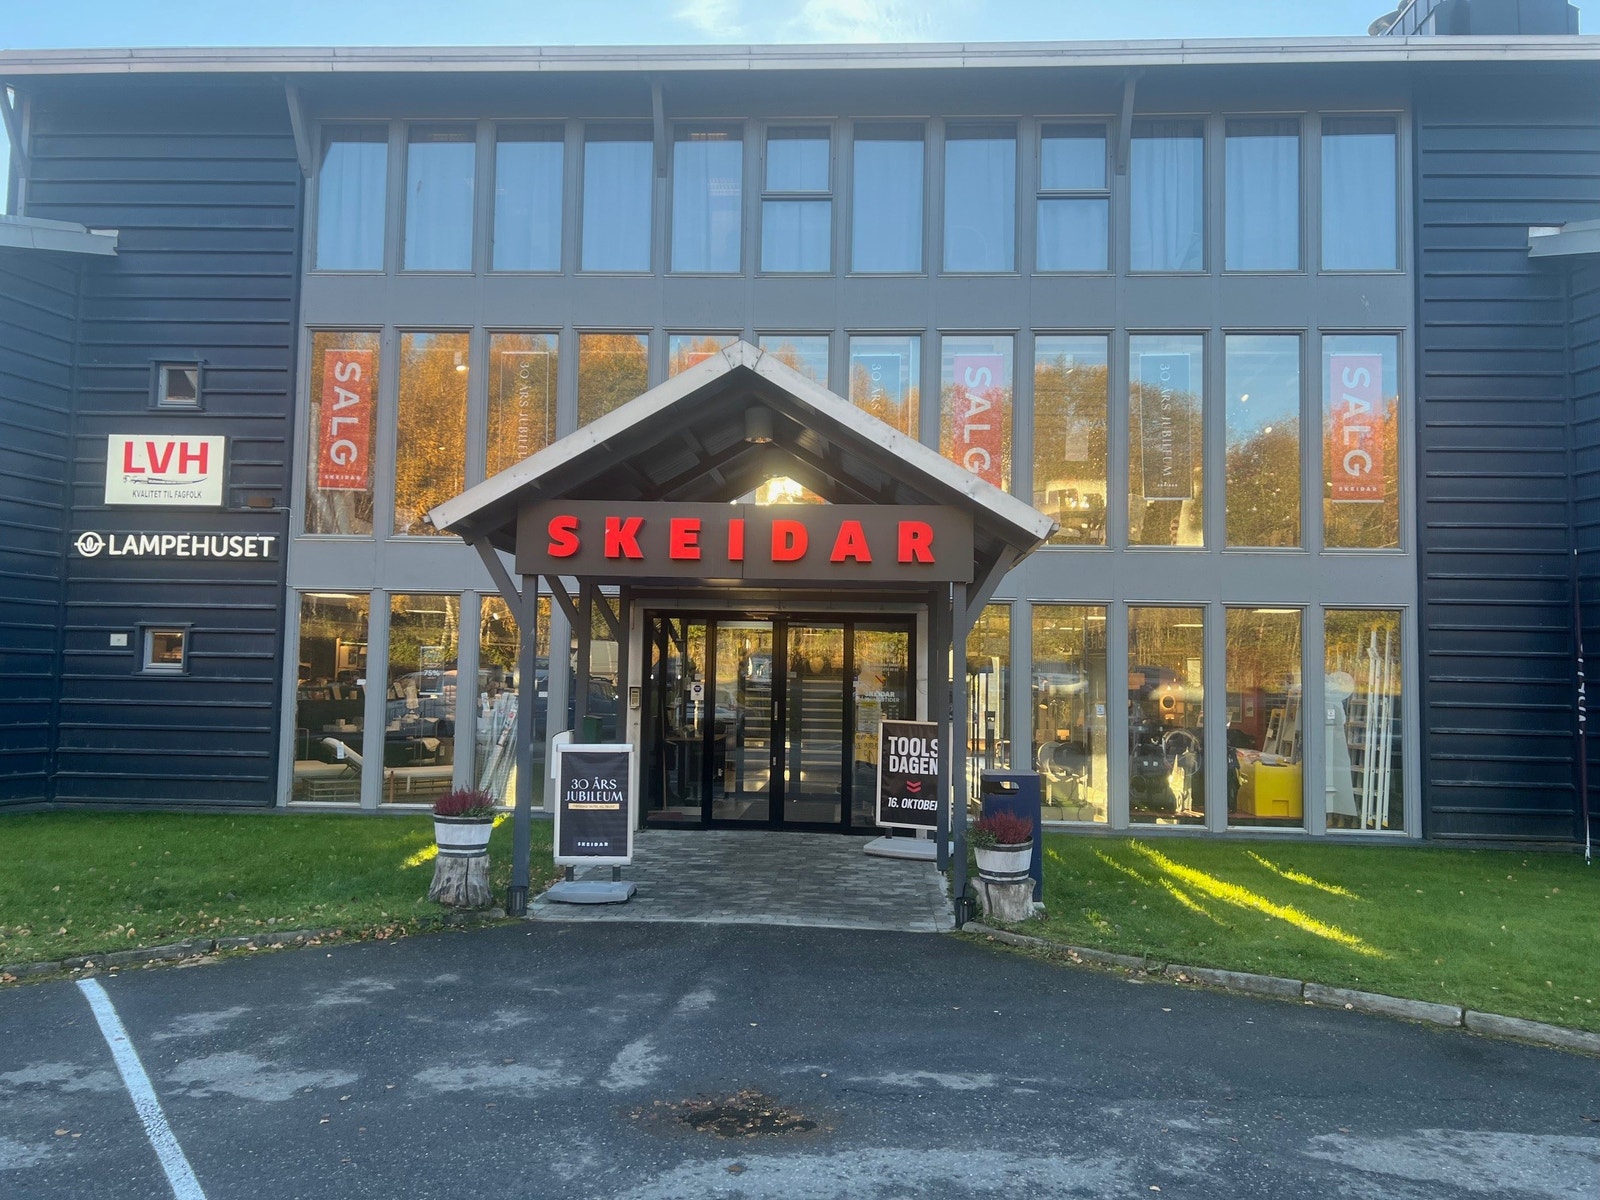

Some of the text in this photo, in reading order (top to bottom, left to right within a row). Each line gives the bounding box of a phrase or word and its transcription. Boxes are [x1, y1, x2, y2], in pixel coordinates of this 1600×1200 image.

[519, 361, 530, 379] 30
[871, 363, 882, 381] 30
[1159, 363, 1171, 381] 30
[330, 361, 362, 466] SALG
[963, 366, 993, 474] SALG
[1341, 366, 1373, 477] SALG
[517, 412, 529, 462] JUBILEU
[123, 440, 209, 474] LVH
[132, 490, 202, 499] KVALITET TIL FAGFOLK
[108, 534, 275, 557] LAMPEHUSET
[547, 515, 936, 564] SKEIDAR
[888, 736, 938, 758] TOOLS
[889, 755, 938, 775] DAGEN
[571, 776, 617, 790] 30 ÅRS
[565, 790, 623, 802] JUBILEUM
[887, 797, 899, 808] 16.
